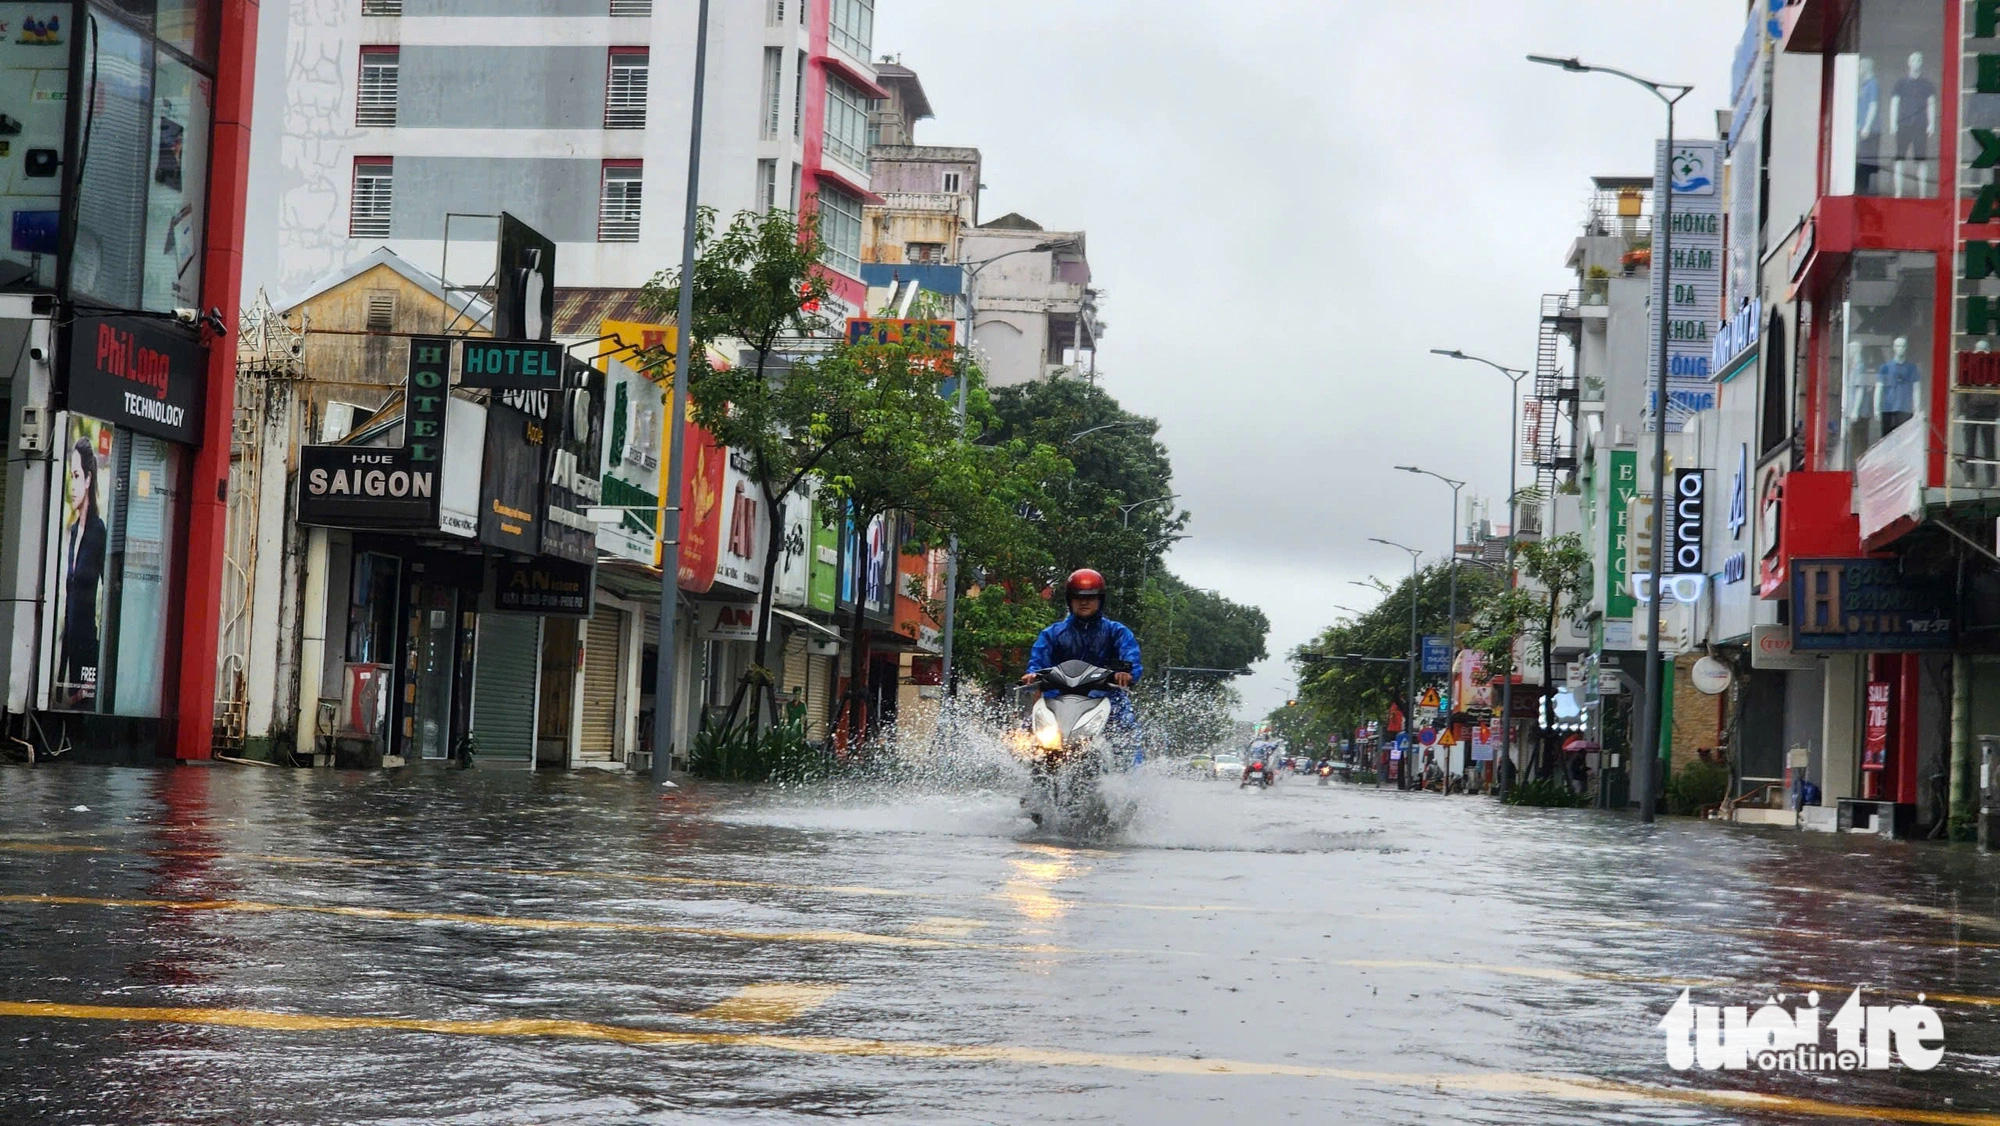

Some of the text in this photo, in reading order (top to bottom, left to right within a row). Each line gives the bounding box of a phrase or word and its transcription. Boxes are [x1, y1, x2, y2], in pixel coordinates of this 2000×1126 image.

[1667, 245, 1713, 269] HÁM
[467, 348, 556, 376] HOTEL
[1666, 352, 1708, 376] ÔNG
[124, 392, 185, 428] TECHNOLOGY
[410, 346, 443, 462] HOTEL
[352, 455, 394, 465] HUE
[308, 468, 433, 498] SAIGON
[81, 666, 96, 681] FREE
[1869, 685, 1889, 701] SALE
